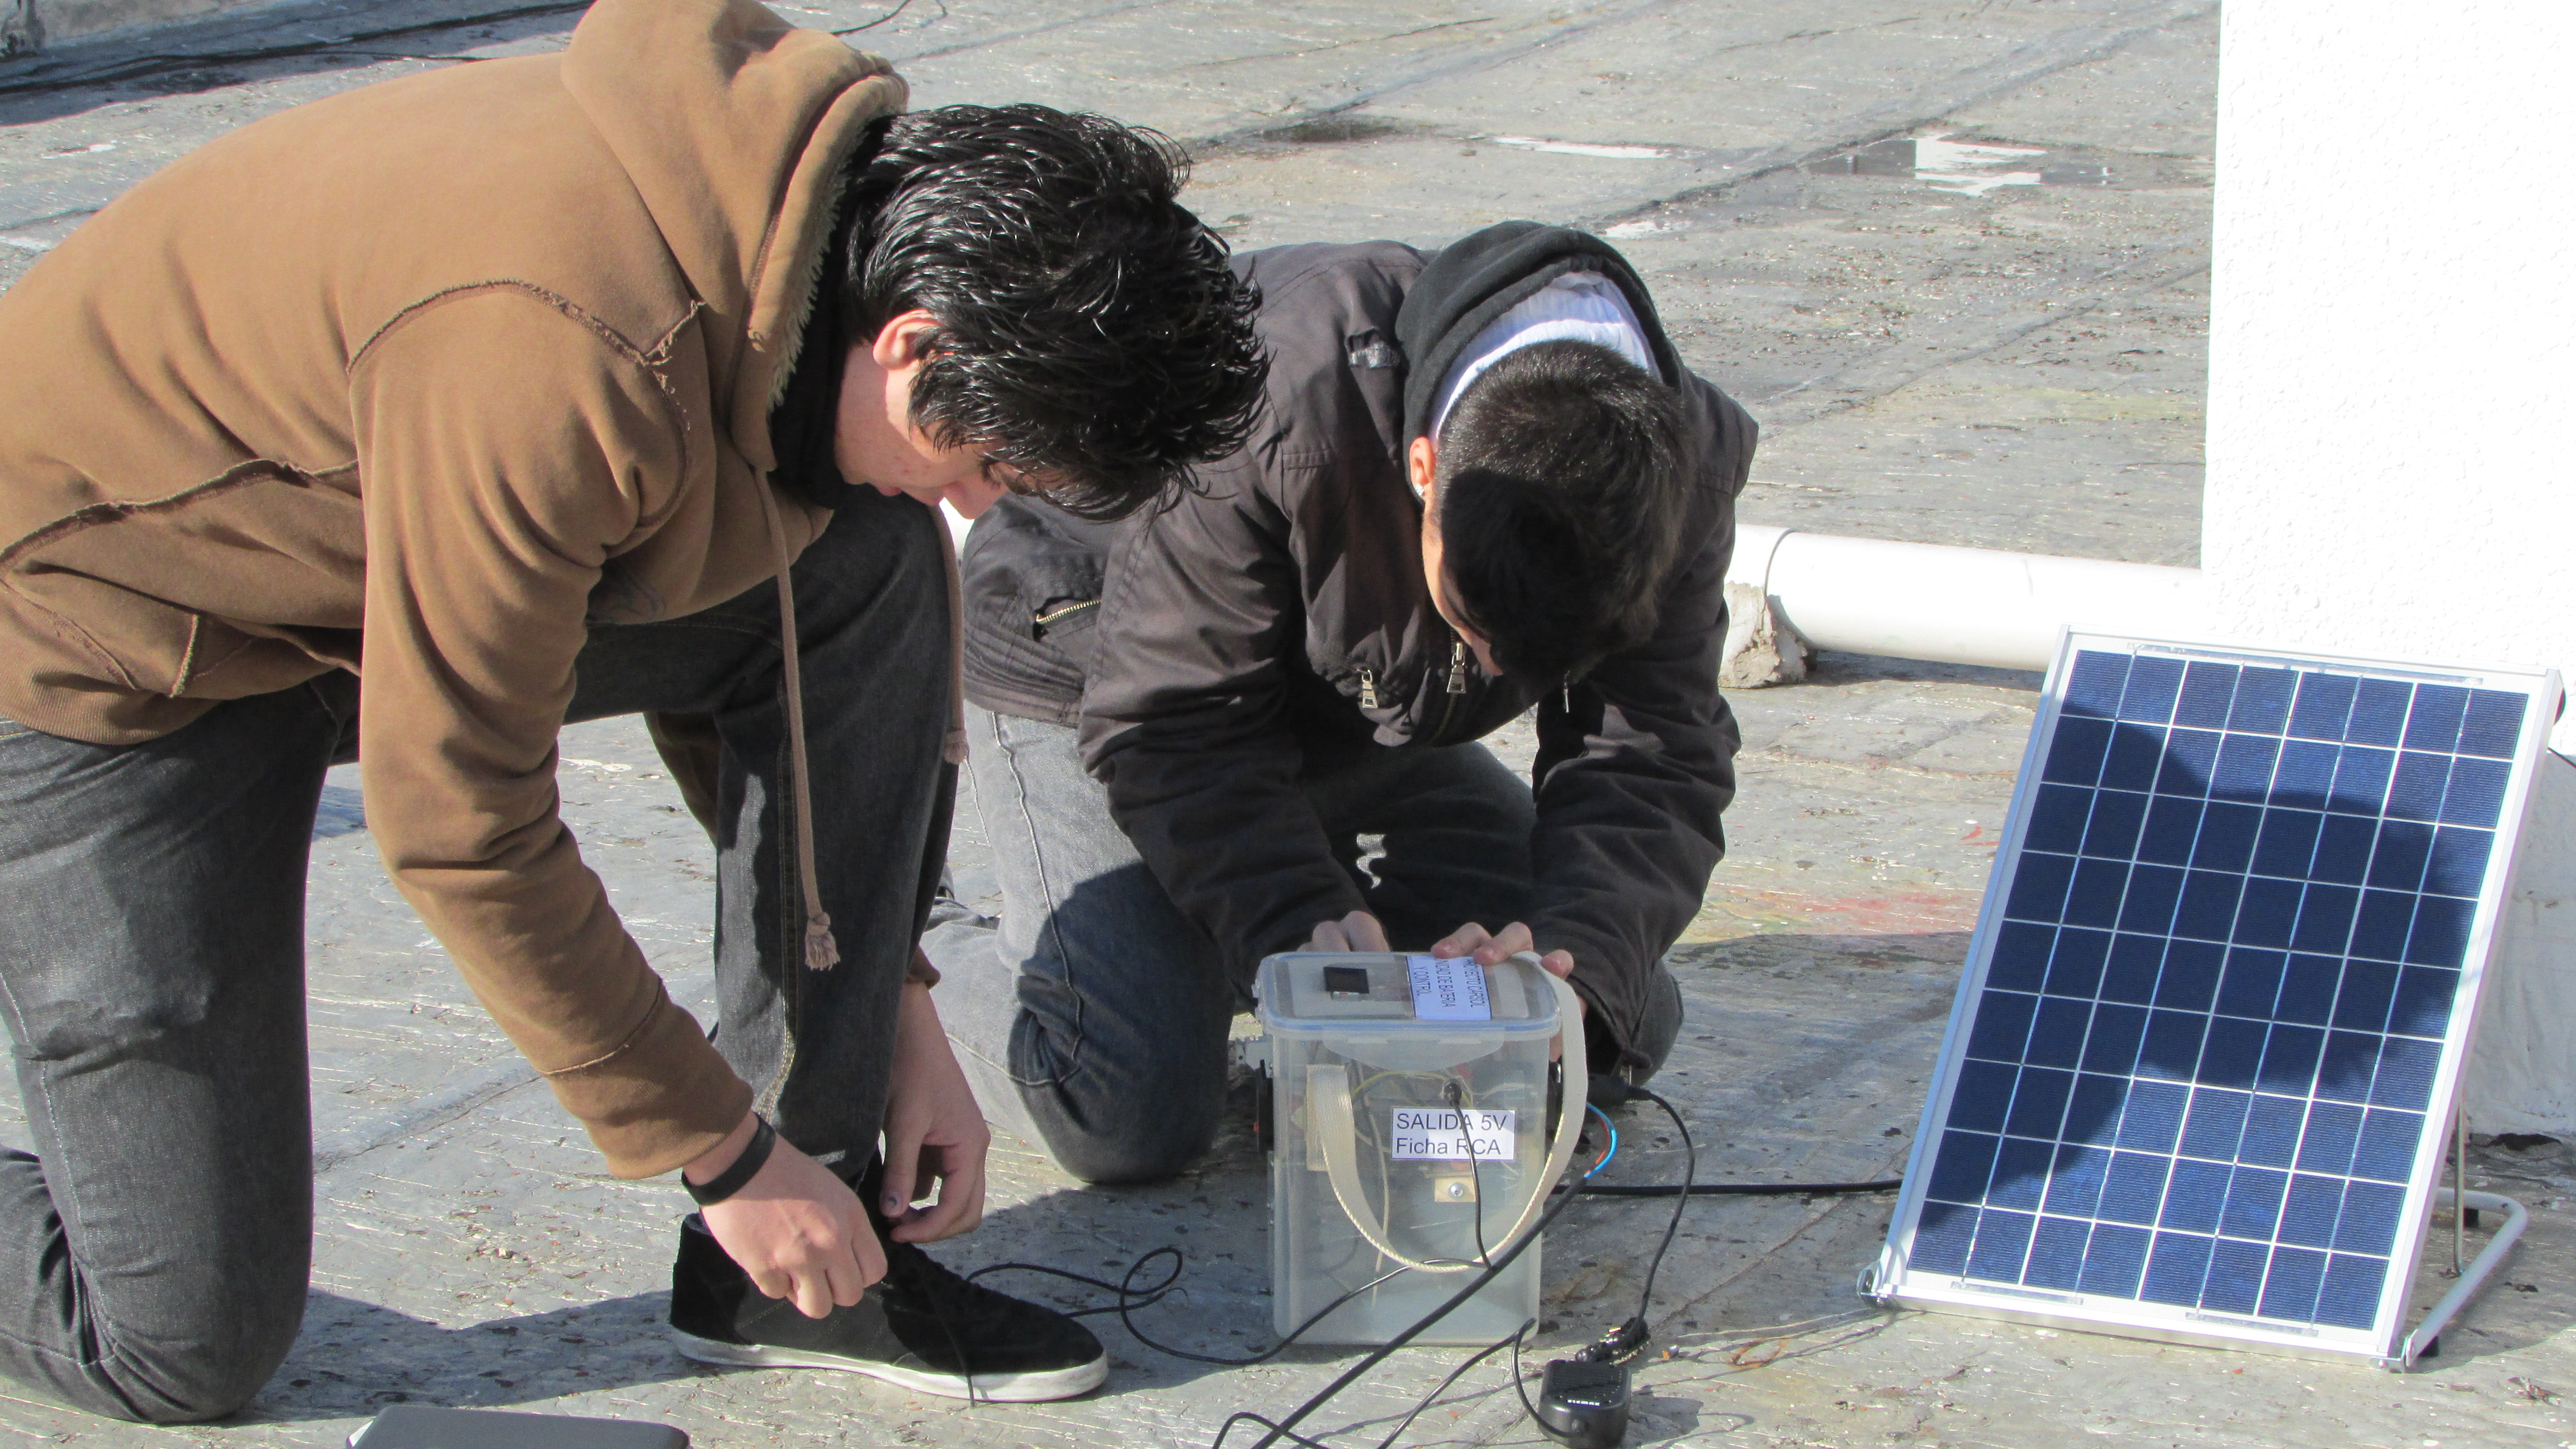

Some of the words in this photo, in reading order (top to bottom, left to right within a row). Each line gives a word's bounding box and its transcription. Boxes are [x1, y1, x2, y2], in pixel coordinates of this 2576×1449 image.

[1414, 971, 1431, 996] CONTROL
[1397, 1113, 1474, 1130] SALIDA
[1481, 1115, 1508, 1131] 5V
[1396, 1138, 1448, 1154] Ficha
[1456, 1138, 1501, 1155] RCA
